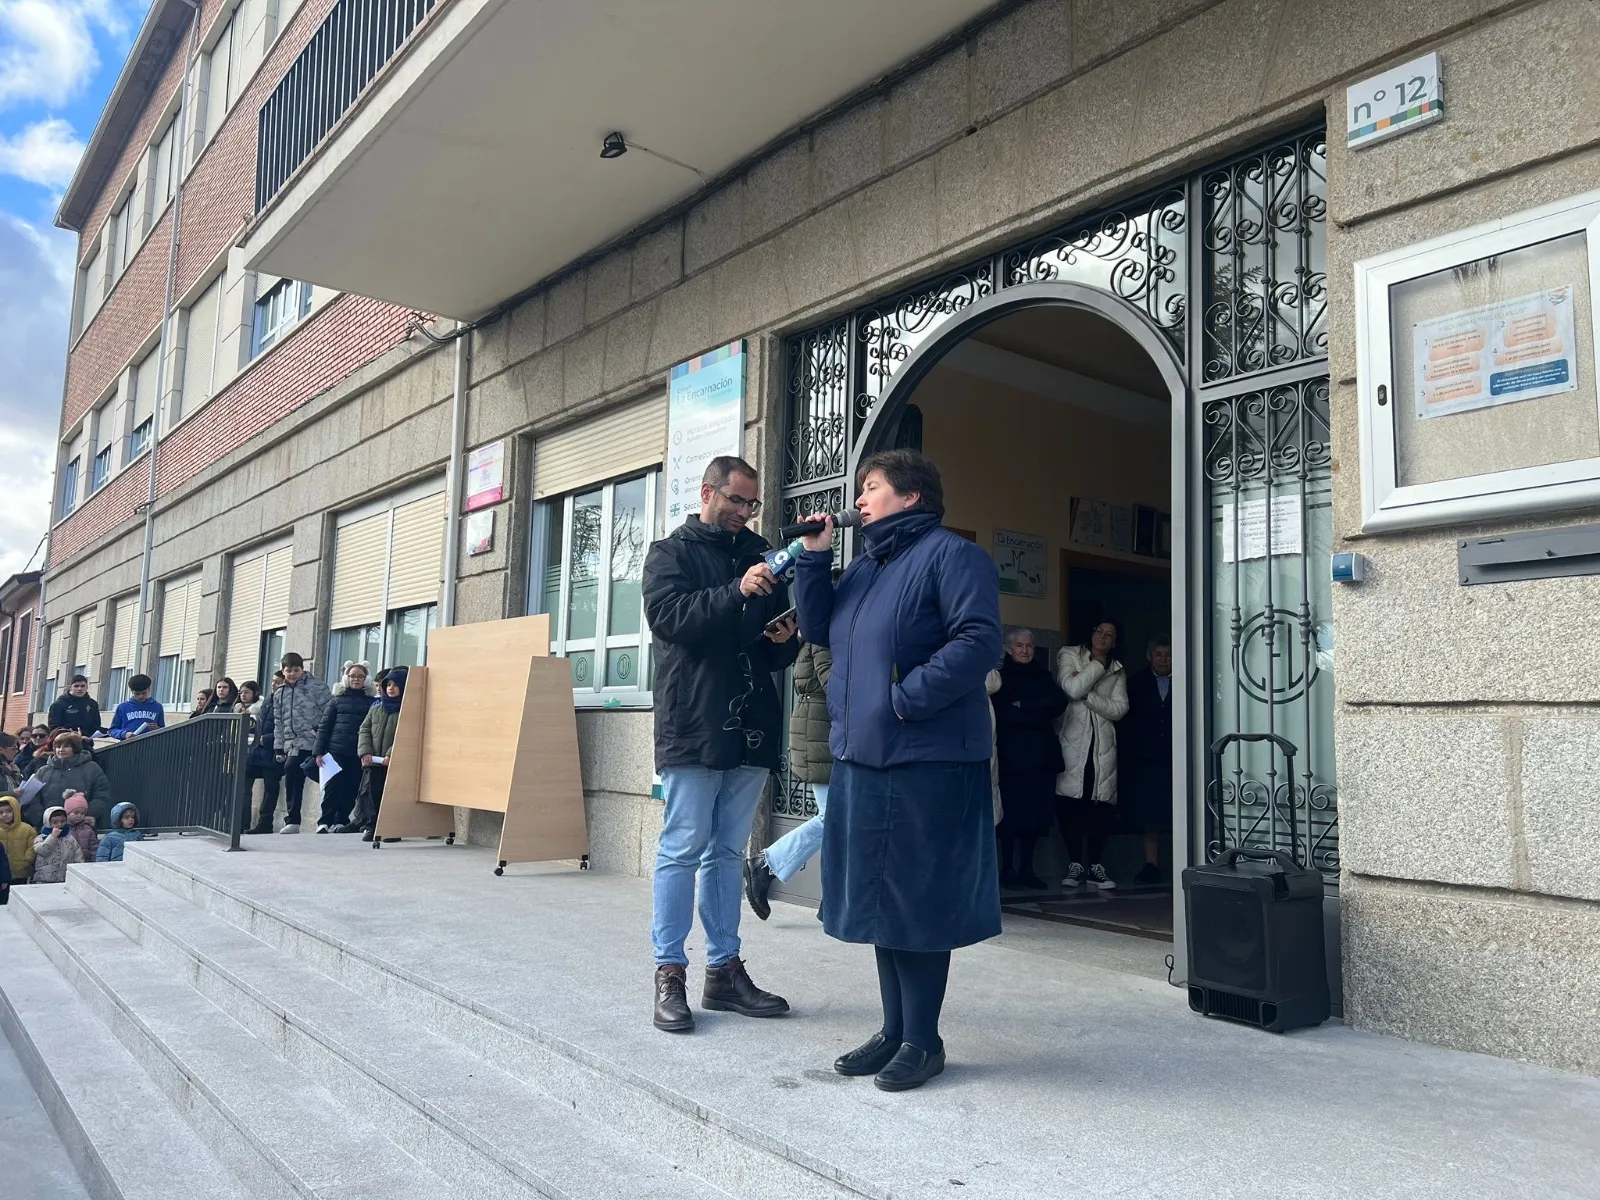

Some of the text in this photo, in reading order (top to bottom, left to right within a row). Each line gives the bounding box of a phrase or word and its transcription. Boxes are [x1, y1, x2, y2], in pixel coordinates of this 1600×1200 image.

[1394, 75, 1428, 106] 12
[1500, 320, 1506, 328] 2
[687, 377, 733, 401] Encarnación
[126, 710, 157, 721] HOODRICH
